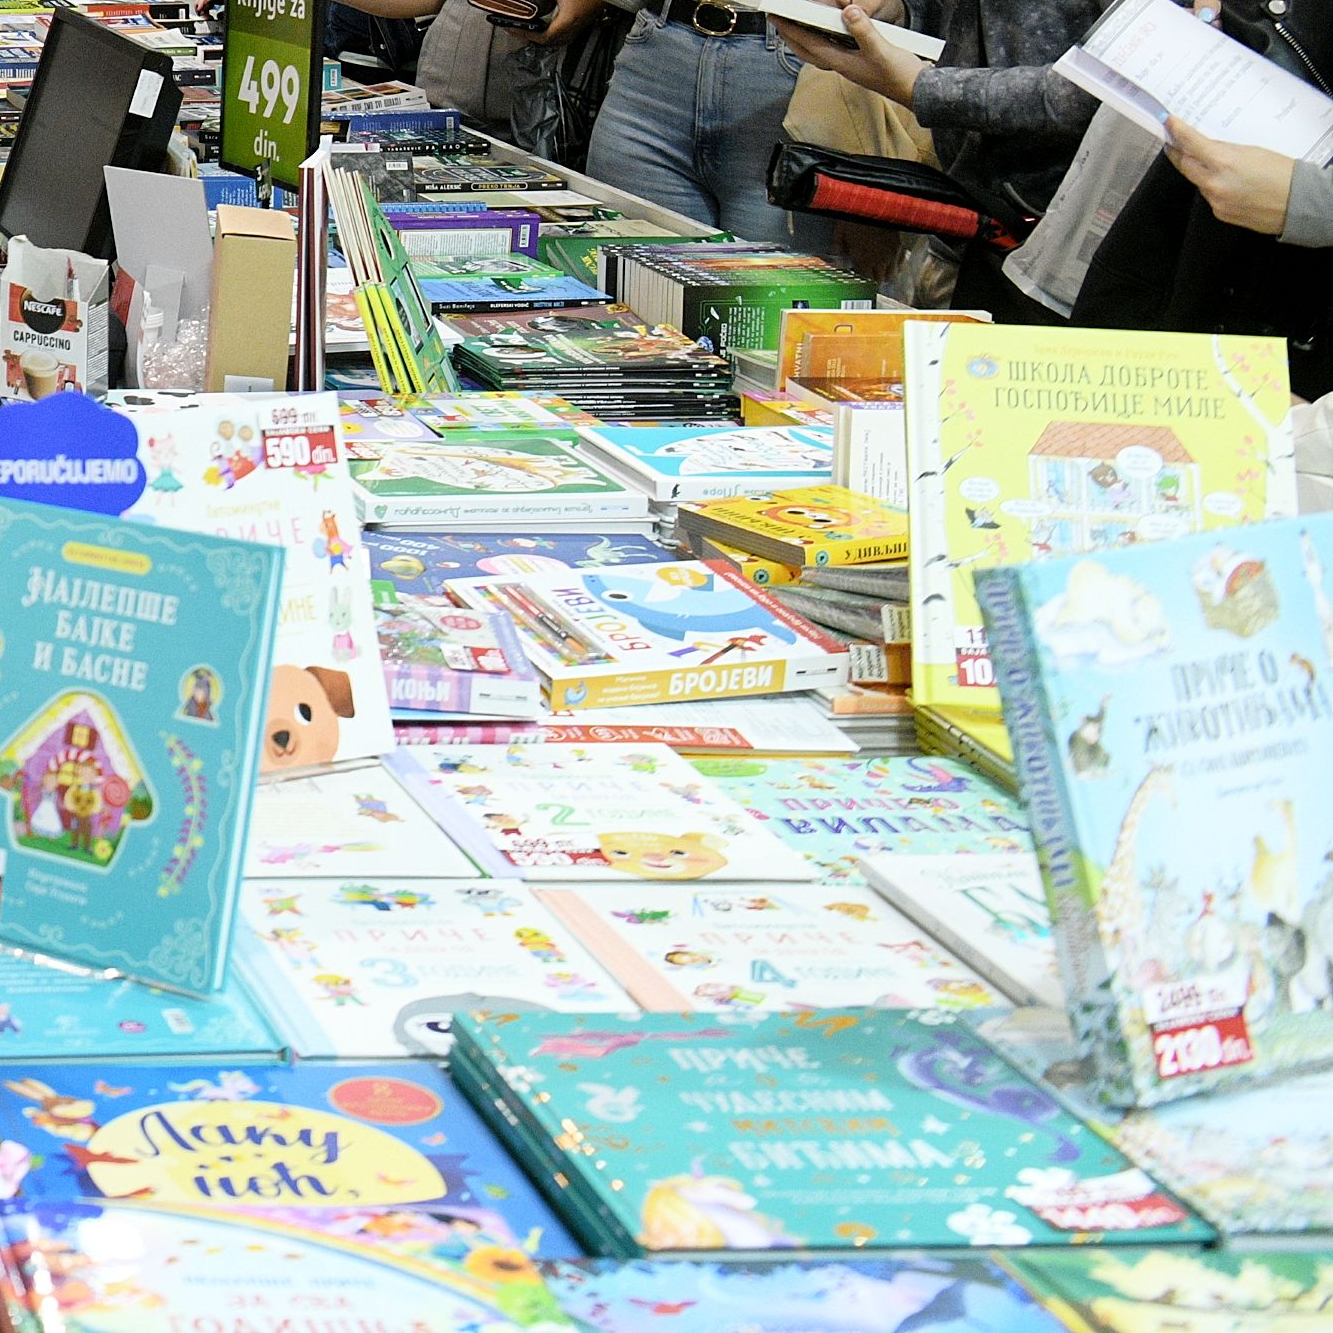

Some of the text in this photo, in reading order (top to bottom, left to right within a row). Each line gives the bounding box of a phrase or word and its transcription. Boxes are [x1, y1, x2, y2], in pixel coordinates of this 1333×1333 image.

[237, 54, 300, 125] 499
[253, 129, 280, 163] din.
[425, 182, 438, 192] MIŠA
[439, 182, 462, 192] ALEKSIĆ
[13, 330, 71, 351] CAPPUCCINO
[1007, 361, 1210, 392] ШКОЛА ДОБРОТЕ
[993, 386, 1227, 421] ГОСПОЂИЦЕ МИЛЕ
[267, 436, 337, 467] 590 din.
[21, 567, 180, 626] НАЈЛЕПШЕ
[55, 610, 136, 652] БАЈКЕ
[34, 641, 149, 693] И БАСНЕ
[668, 665, 773, 697] БРОЈЕВИ
[391, 677, 451, 702] КОЊИ
[358, 955, 420, 989] 3
[750, 959, 796, 987] 4
[1155, 1026, 1223, 1077] 2130
[134, 1110, 353, 1166] Лаку
